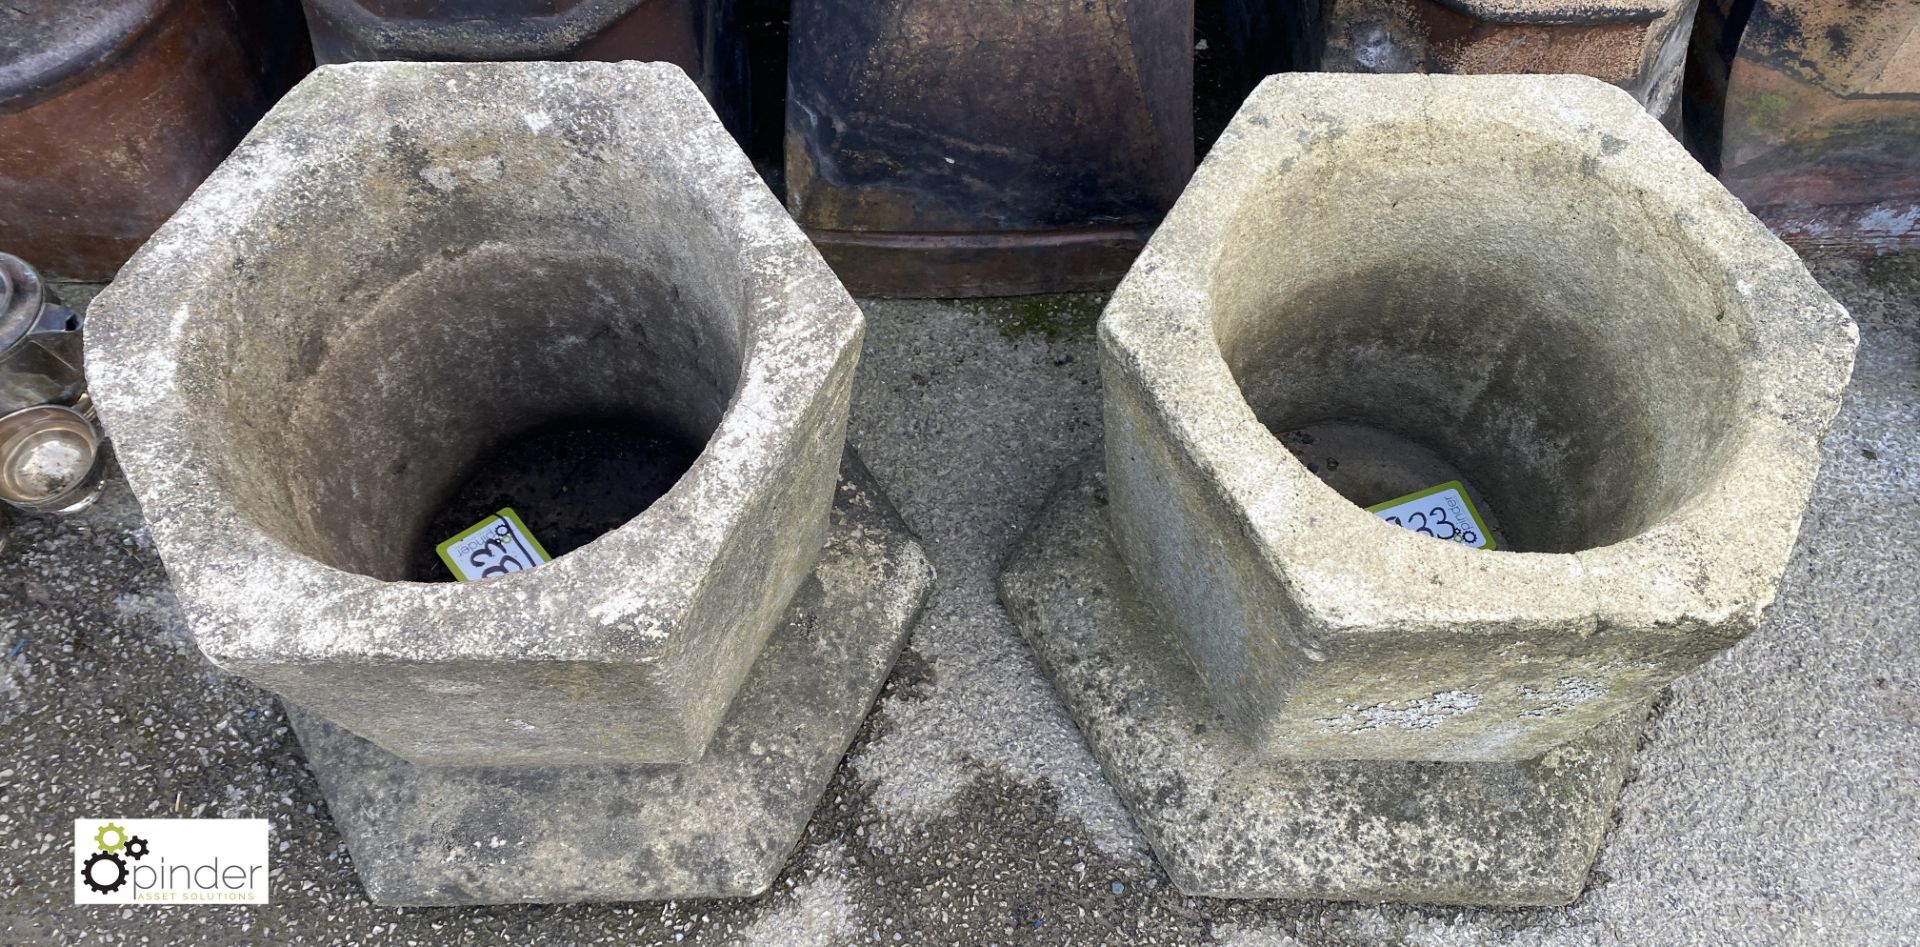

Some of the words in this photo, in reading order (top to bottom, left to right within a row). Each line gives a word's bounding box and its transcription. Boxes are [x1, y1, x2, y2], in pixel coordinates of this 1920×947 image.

[1385, 506, 1457, 540] 33
[1443, 495, 1474, 531] pinder
[457, 528, 498, 558] pinder
